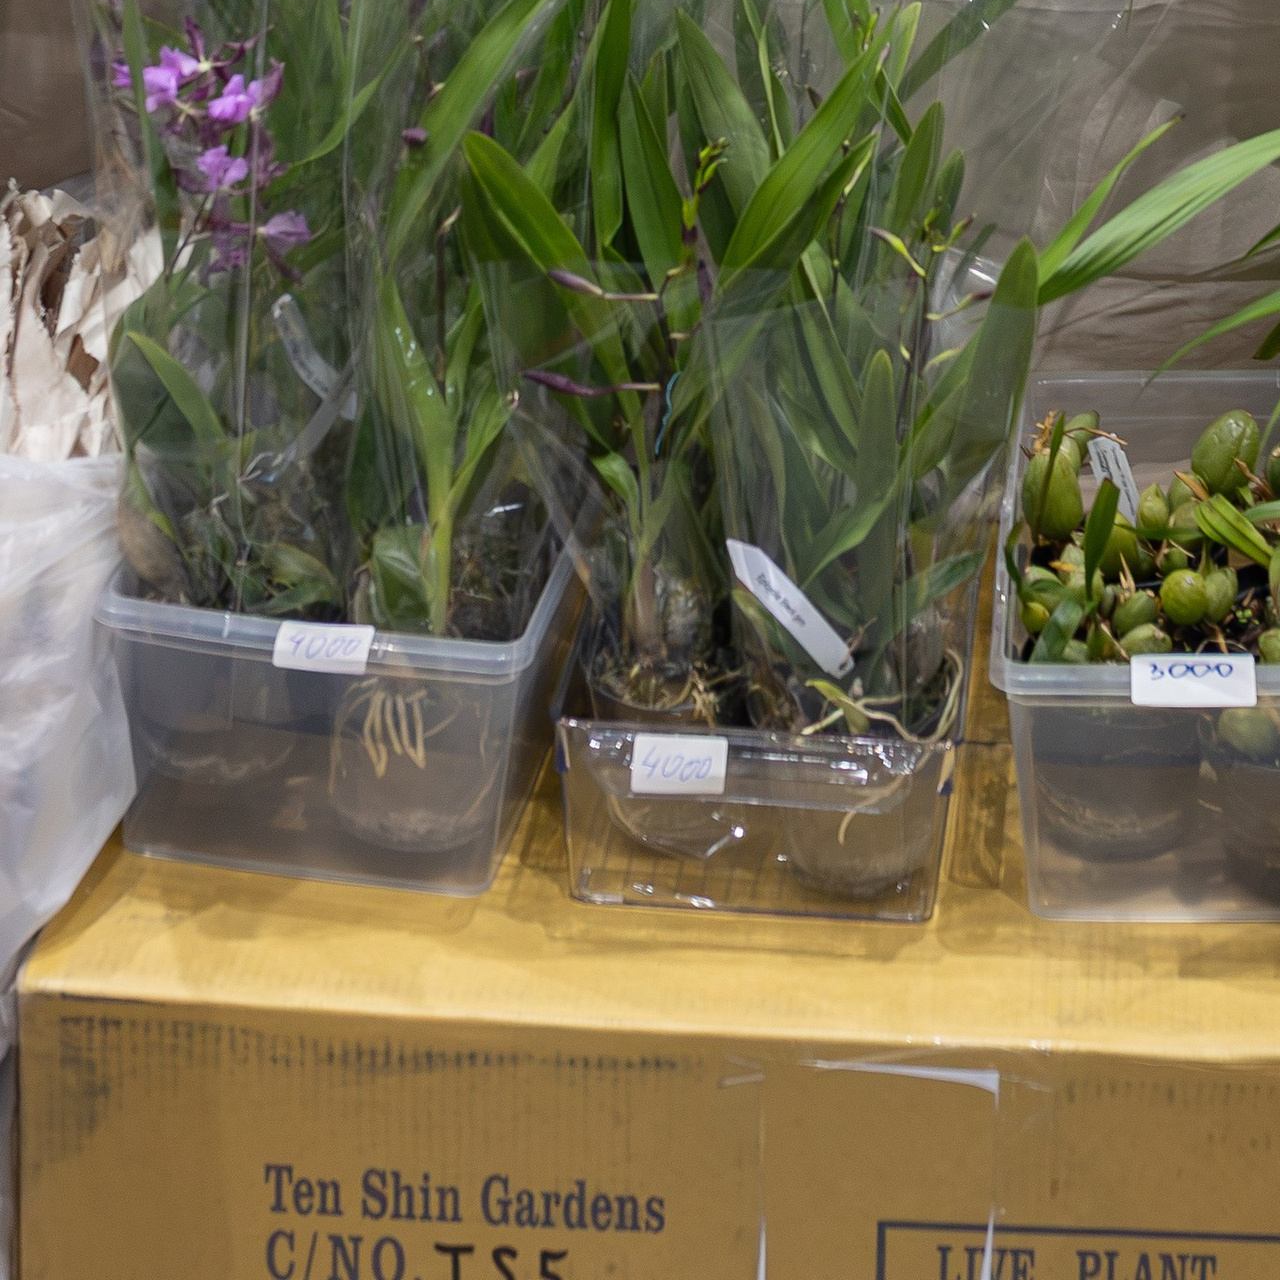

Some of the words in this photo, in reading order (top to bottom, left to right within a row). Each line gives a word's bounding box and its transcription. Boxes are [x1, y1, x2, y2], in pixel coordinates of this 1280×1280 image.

[289, 629, 361, 660] 4000
[1149, 661, 1234, 681] 3000
[641, 745, 714, 783] 4000
[264, 1163, 344, 1217] Ten
[361, 1167, 463, 1223] Shin
[480, 1173, 666, 1234] Gardens
